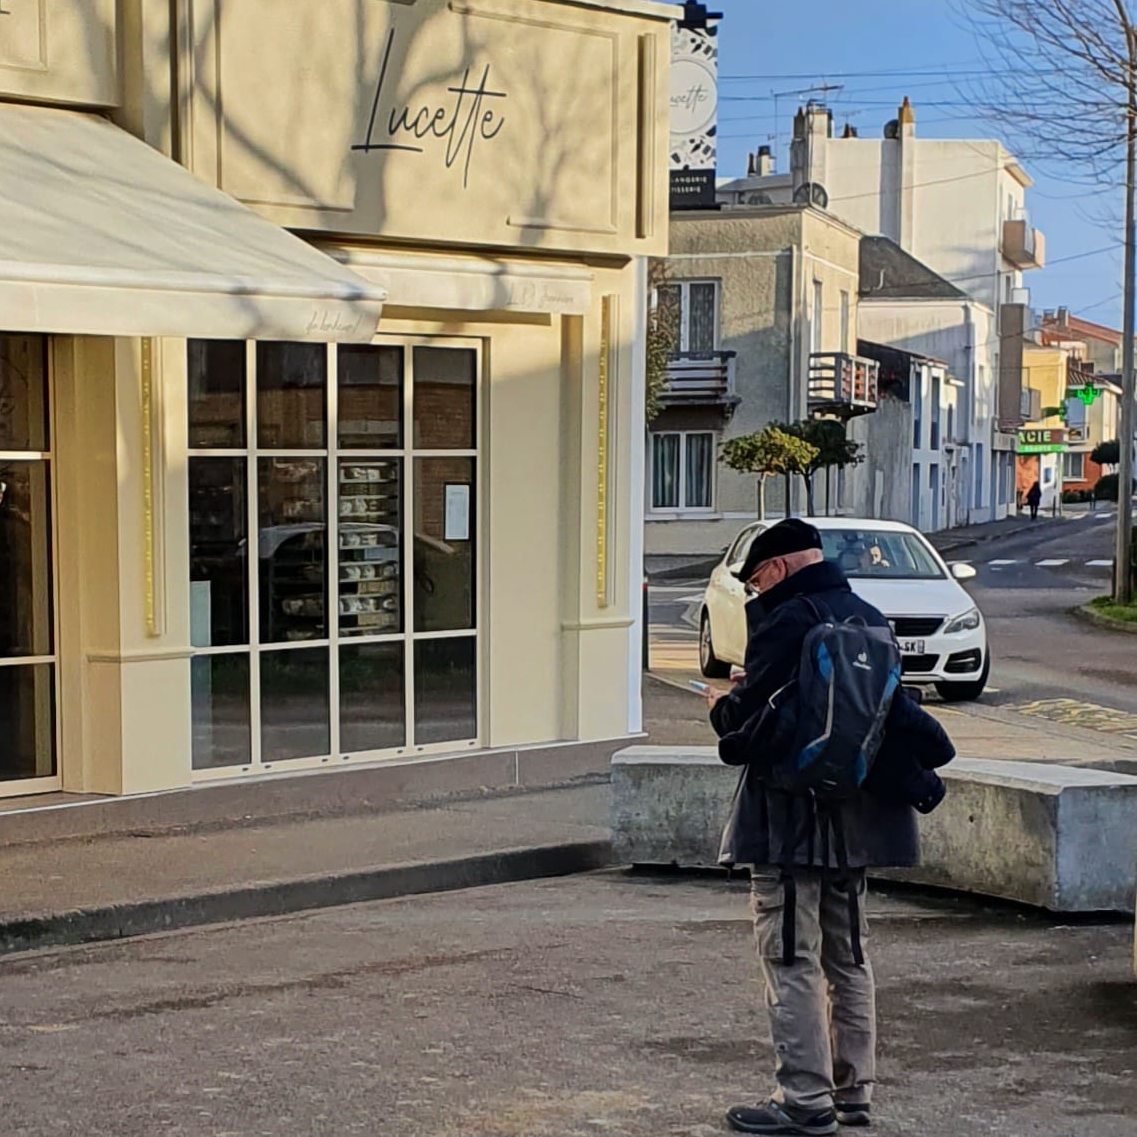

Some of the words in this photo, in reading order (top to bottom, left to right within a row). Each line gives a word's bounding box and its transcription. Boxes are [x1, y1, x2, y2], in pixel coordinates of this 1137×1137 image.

[351, 27, 507, 189] Lucette
[669, 84, 709, 113] ucette
[1018, 430, 1051, 443] ACIE
